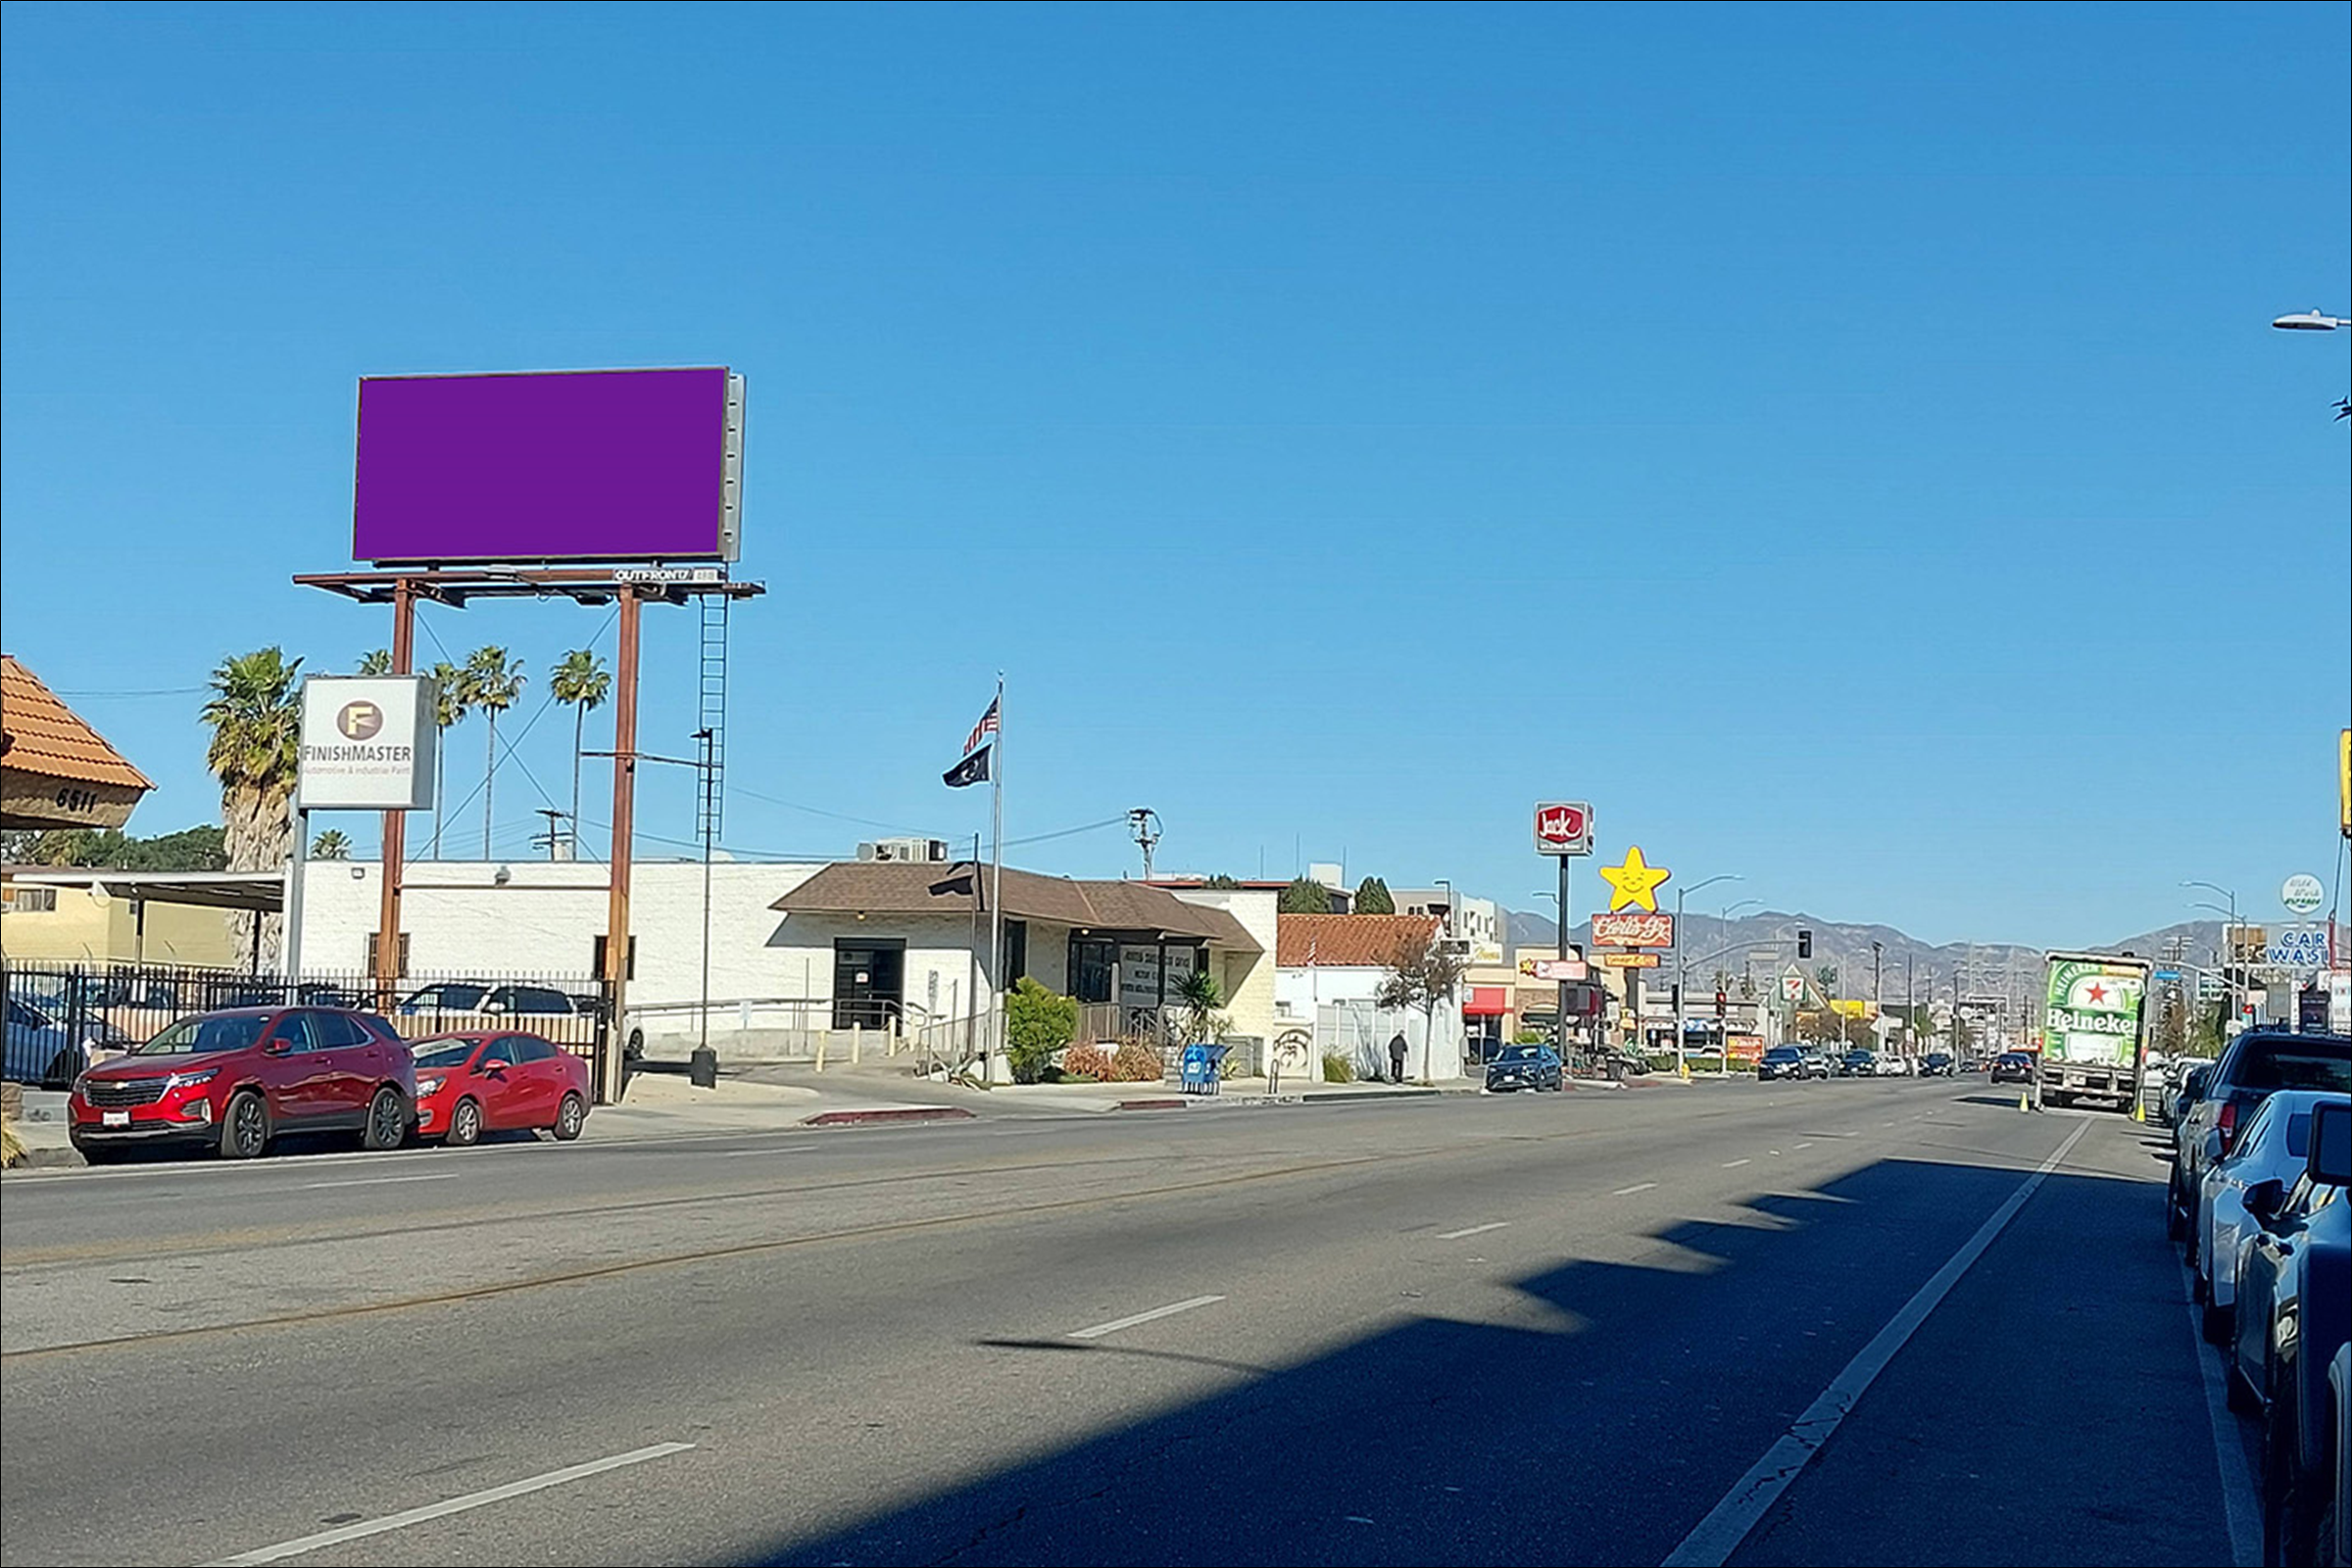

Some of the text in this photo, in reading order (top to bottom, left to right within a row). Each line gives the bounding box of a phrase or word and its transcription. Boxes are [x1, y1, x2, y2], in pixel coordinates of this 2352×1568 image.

[56, 788, 97, 814] 6511
[1540, 809, 1582, 837] Jack
[2281, 931, 2327, 948] CAR
